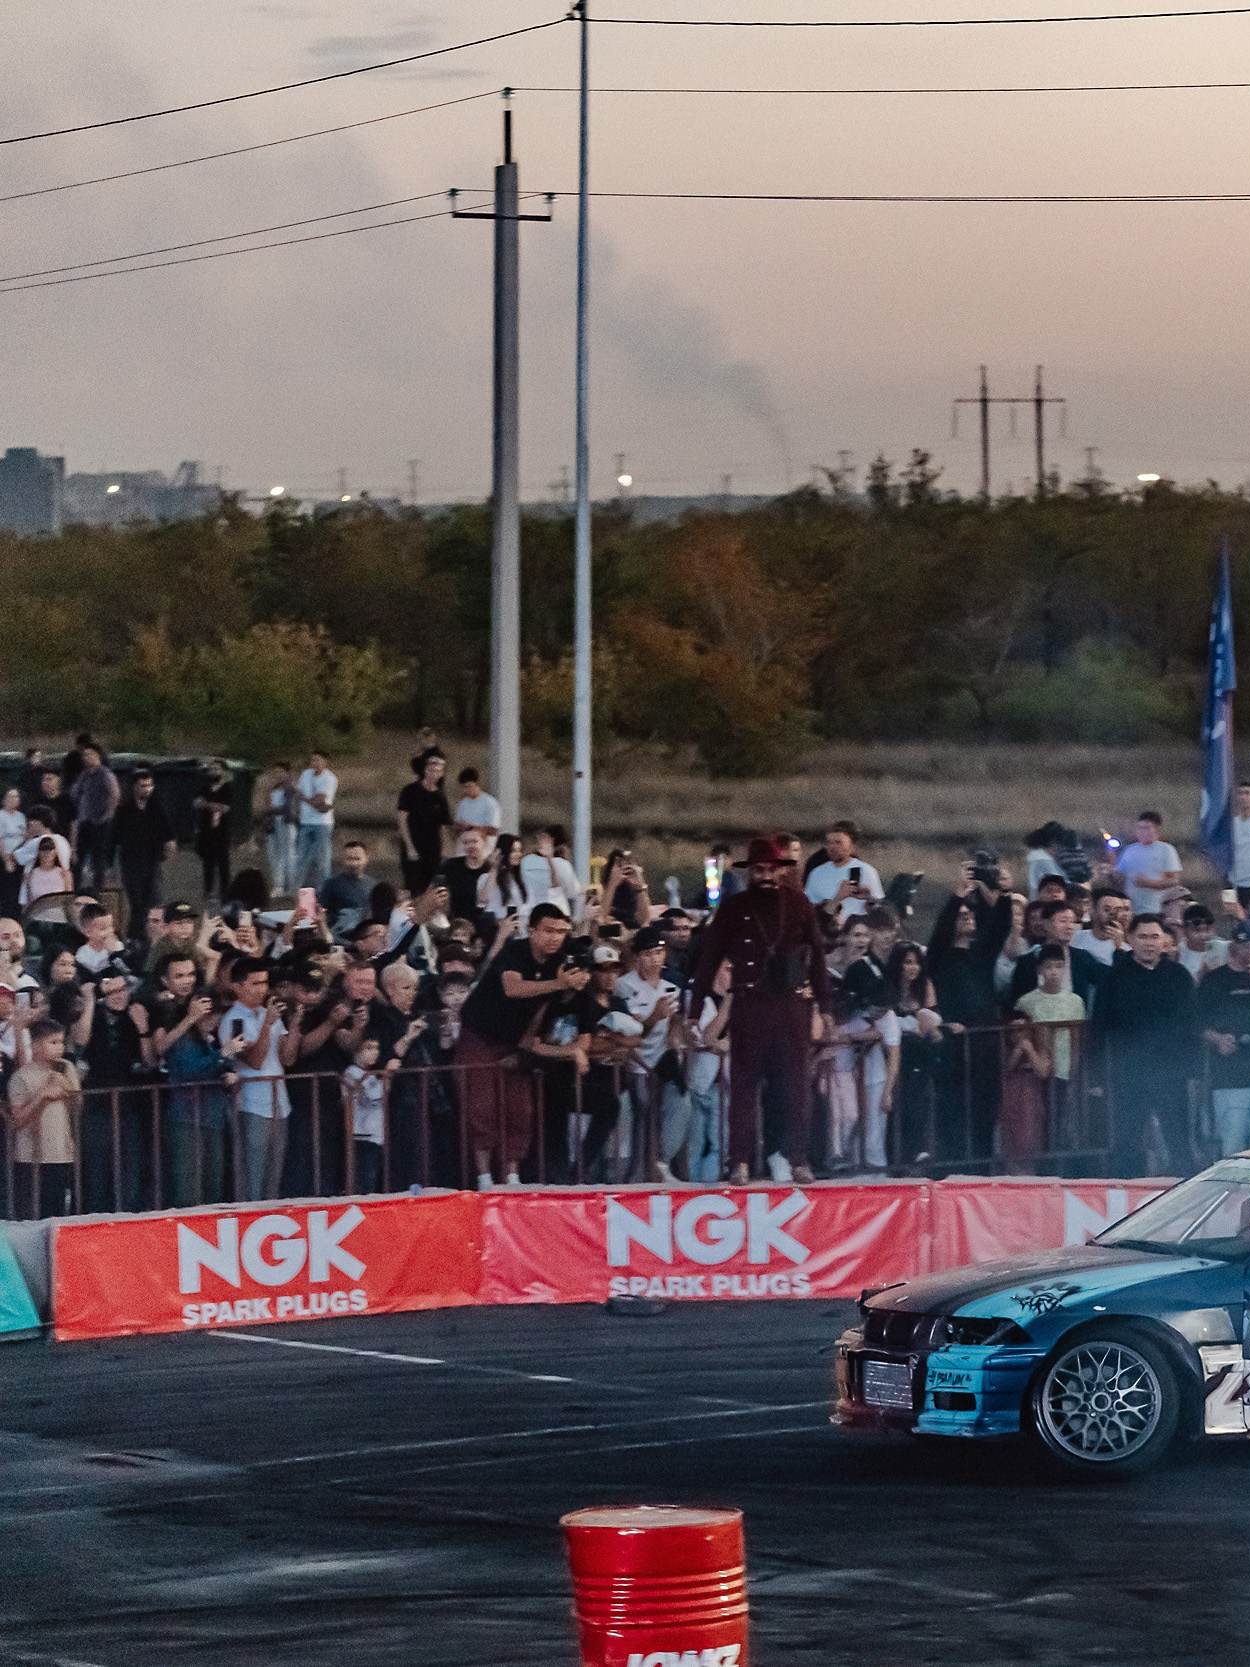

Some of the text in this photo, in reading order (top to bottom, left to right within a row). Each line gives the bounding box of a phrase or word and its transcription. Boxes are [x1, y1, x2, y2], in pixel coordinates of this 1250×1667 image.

[178, 1205, 367, 1294] NGK
[606, 1189, 811, 1267] NGK
[182, 1289, 368, 1326] SPARK PLUGS
[609, 1273, 812, 1298] SPARK PLUGS
